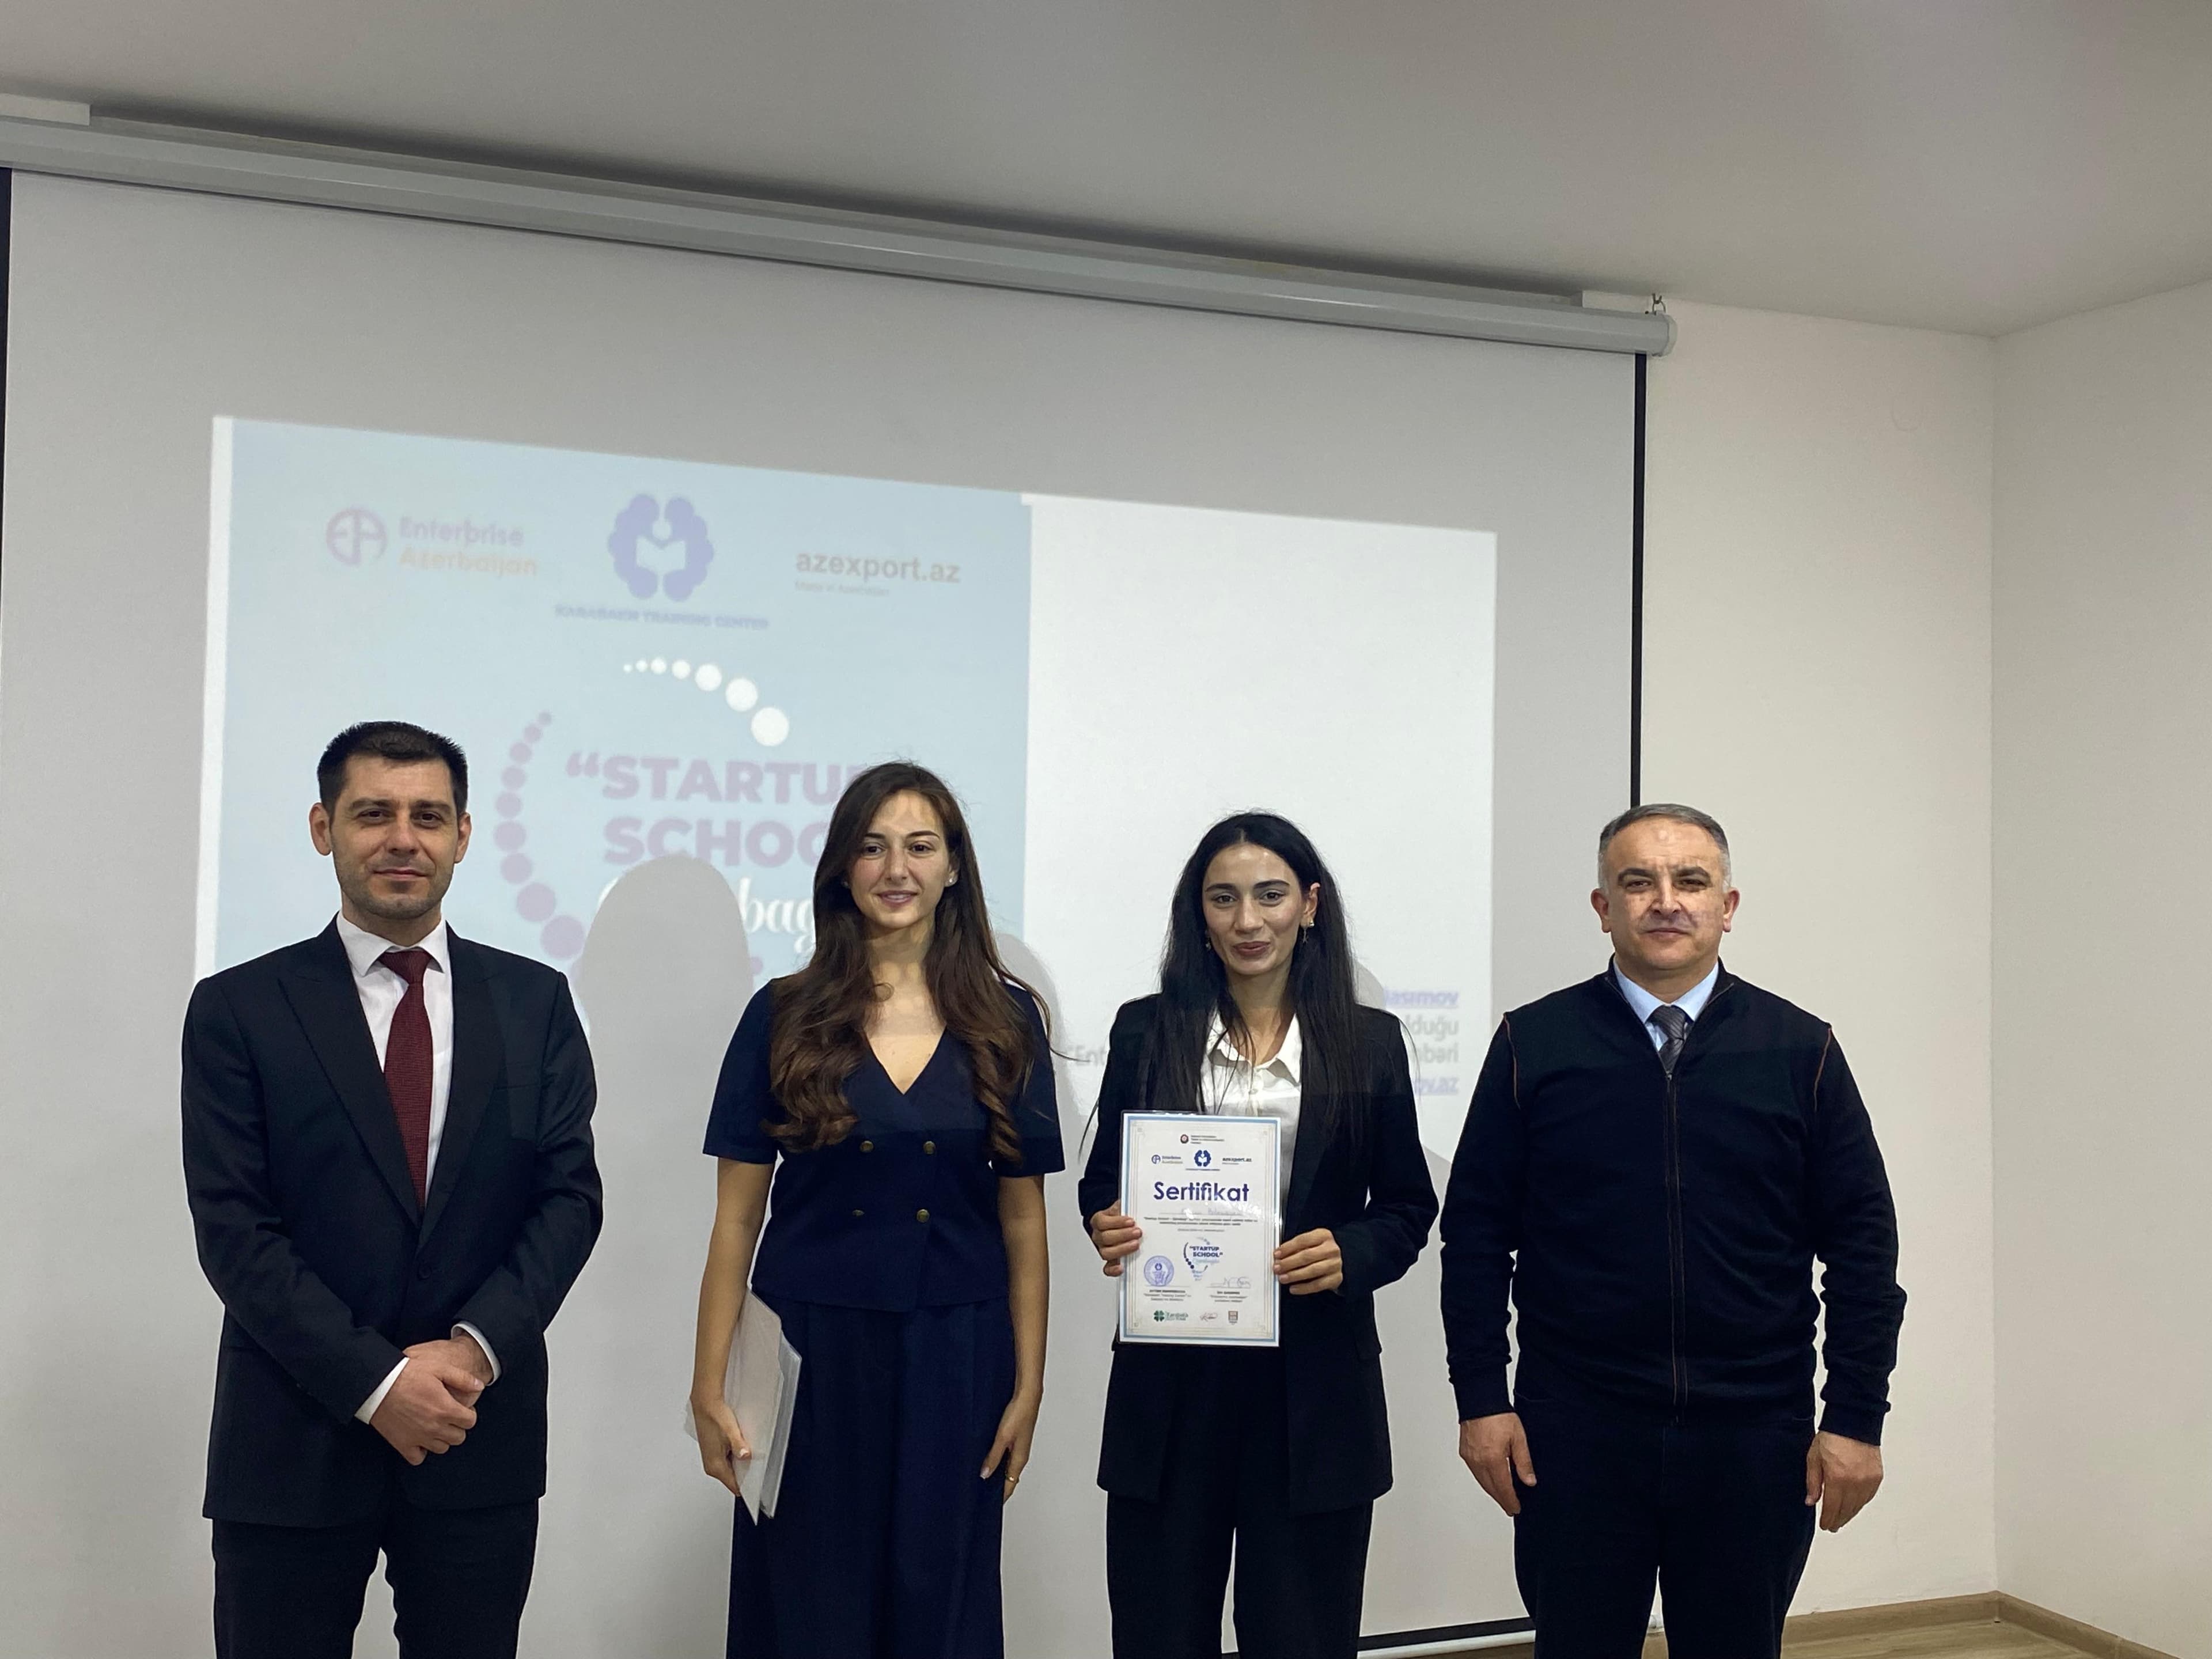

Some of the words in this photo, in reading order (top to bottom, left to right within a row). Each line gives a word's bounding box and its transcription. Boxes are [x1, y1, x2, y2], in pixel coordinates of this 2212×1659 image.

[399, 546, 539, 578] Azerbaijan
[795, 552, 962, 584] azexport.az
[1154, 1181, 1249, 1202] Sertifikat
